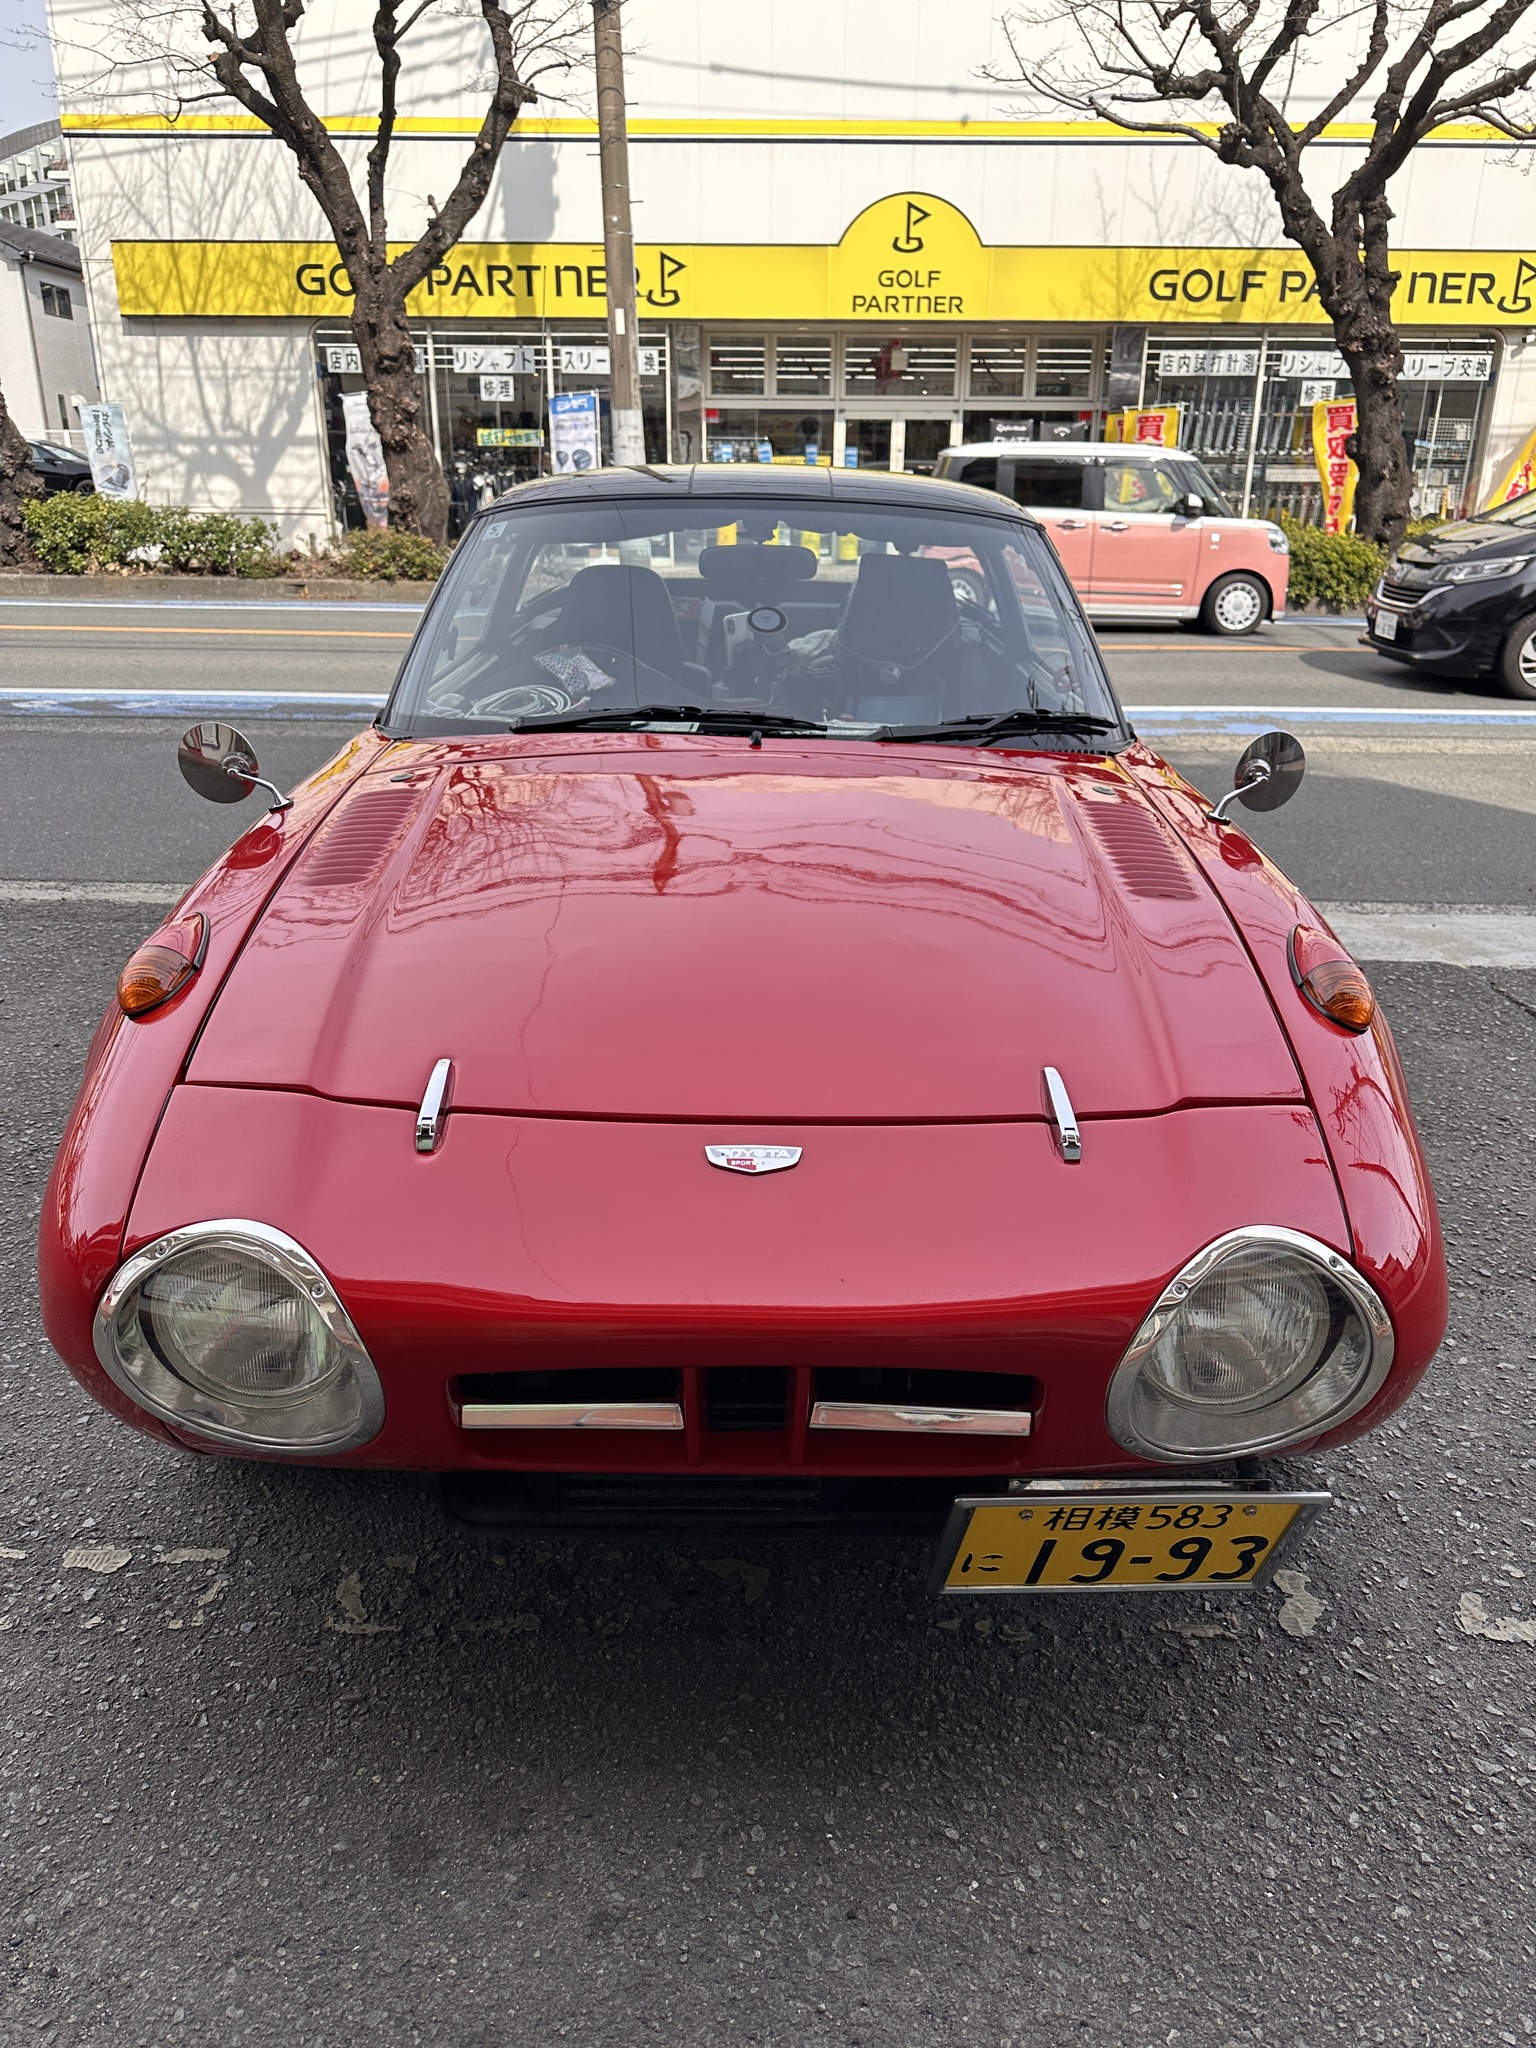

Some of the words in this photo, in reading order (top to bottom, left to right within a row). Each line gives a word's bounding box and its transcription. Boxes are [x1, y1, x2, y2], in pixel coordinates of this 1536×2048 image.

[296, 263, 356, 297] GO
[427, 264, 644, 298] PARTNE
[878, 269, 941, 288] GOLF
[1149, 269, 1267, 301] GOLF
[852, 295, 963, 314] PARTNER
[454, 350, 532, 371] リシャフト
[1162, 353, 1255, 373] 店内試打計測
[1403, 357, 1487, 378] リーブ交換
[483, 380, 512, 397] 修理
[961, 1552, 1004, 1574] に
[1024, 1535, 1270, 1585] 19-93
